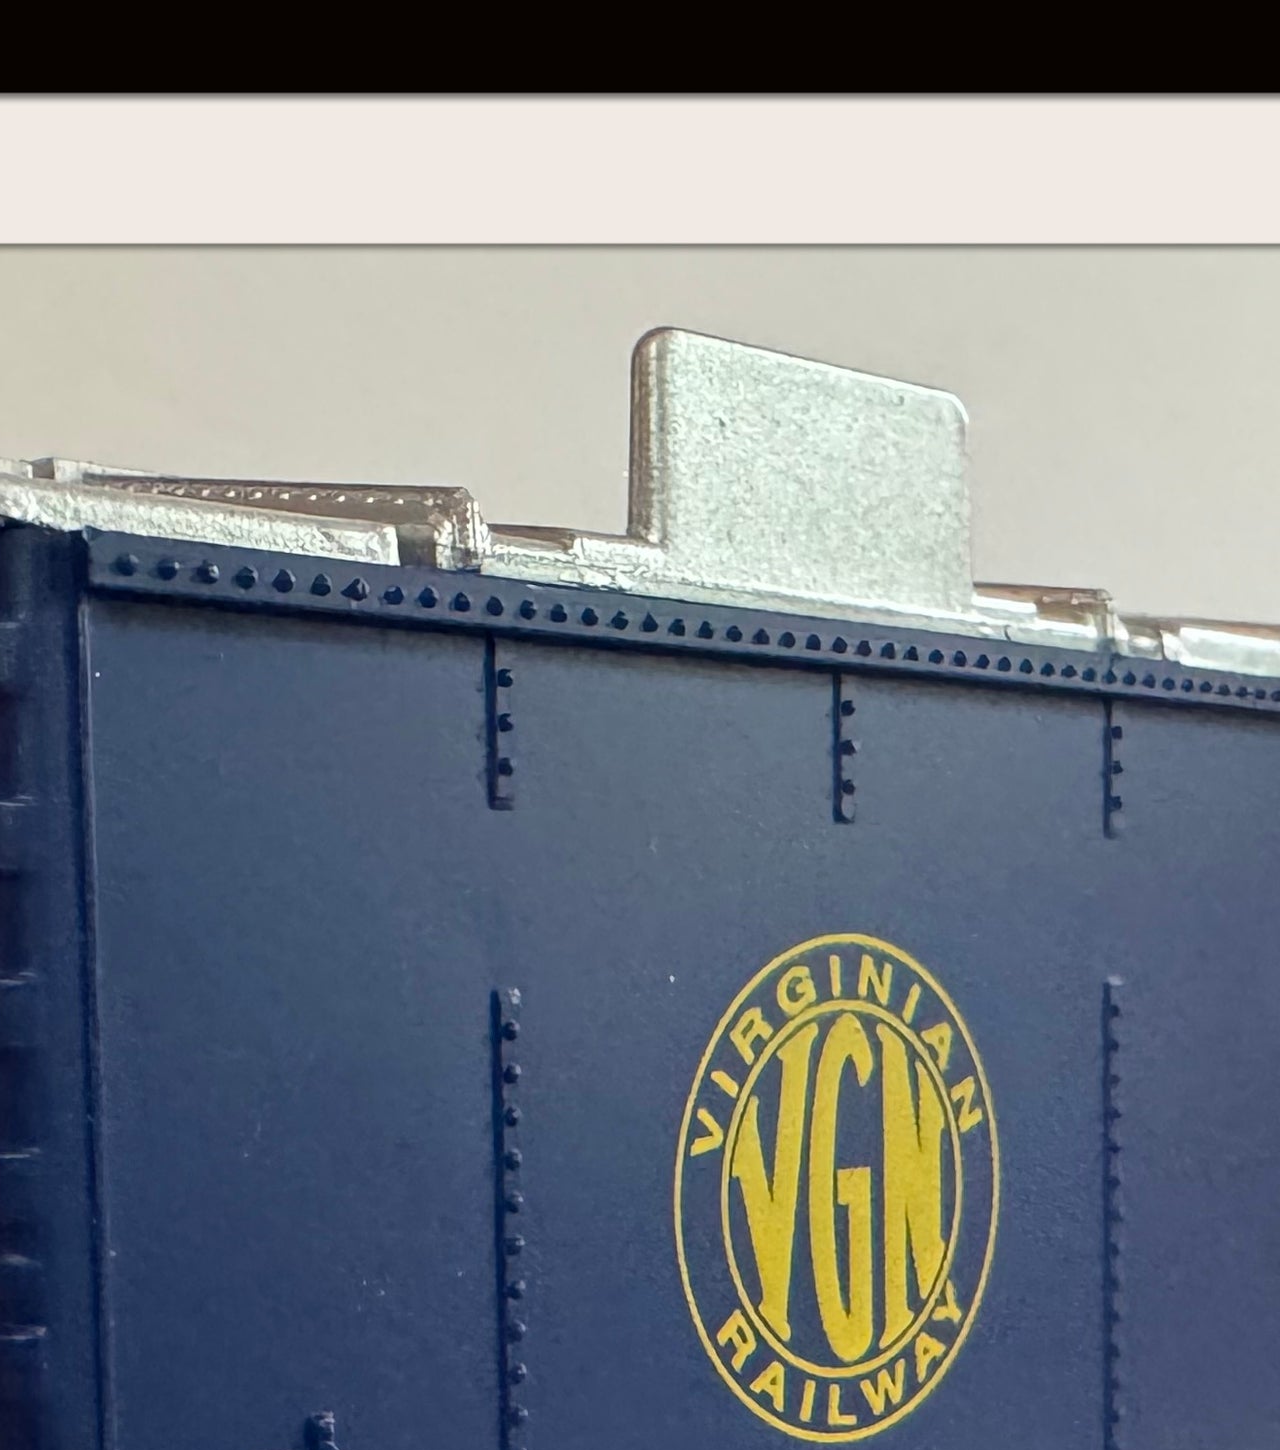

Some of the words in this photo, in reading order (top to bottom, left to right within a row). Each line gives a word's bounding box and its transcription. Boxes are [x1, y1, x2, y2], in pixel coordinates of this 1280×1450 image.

[690, 955, 982, 1155] VIRGINIAN
[732, 1014, 946, 1362] VGN
[717, 1281, 962, 1426] RAILWAY
